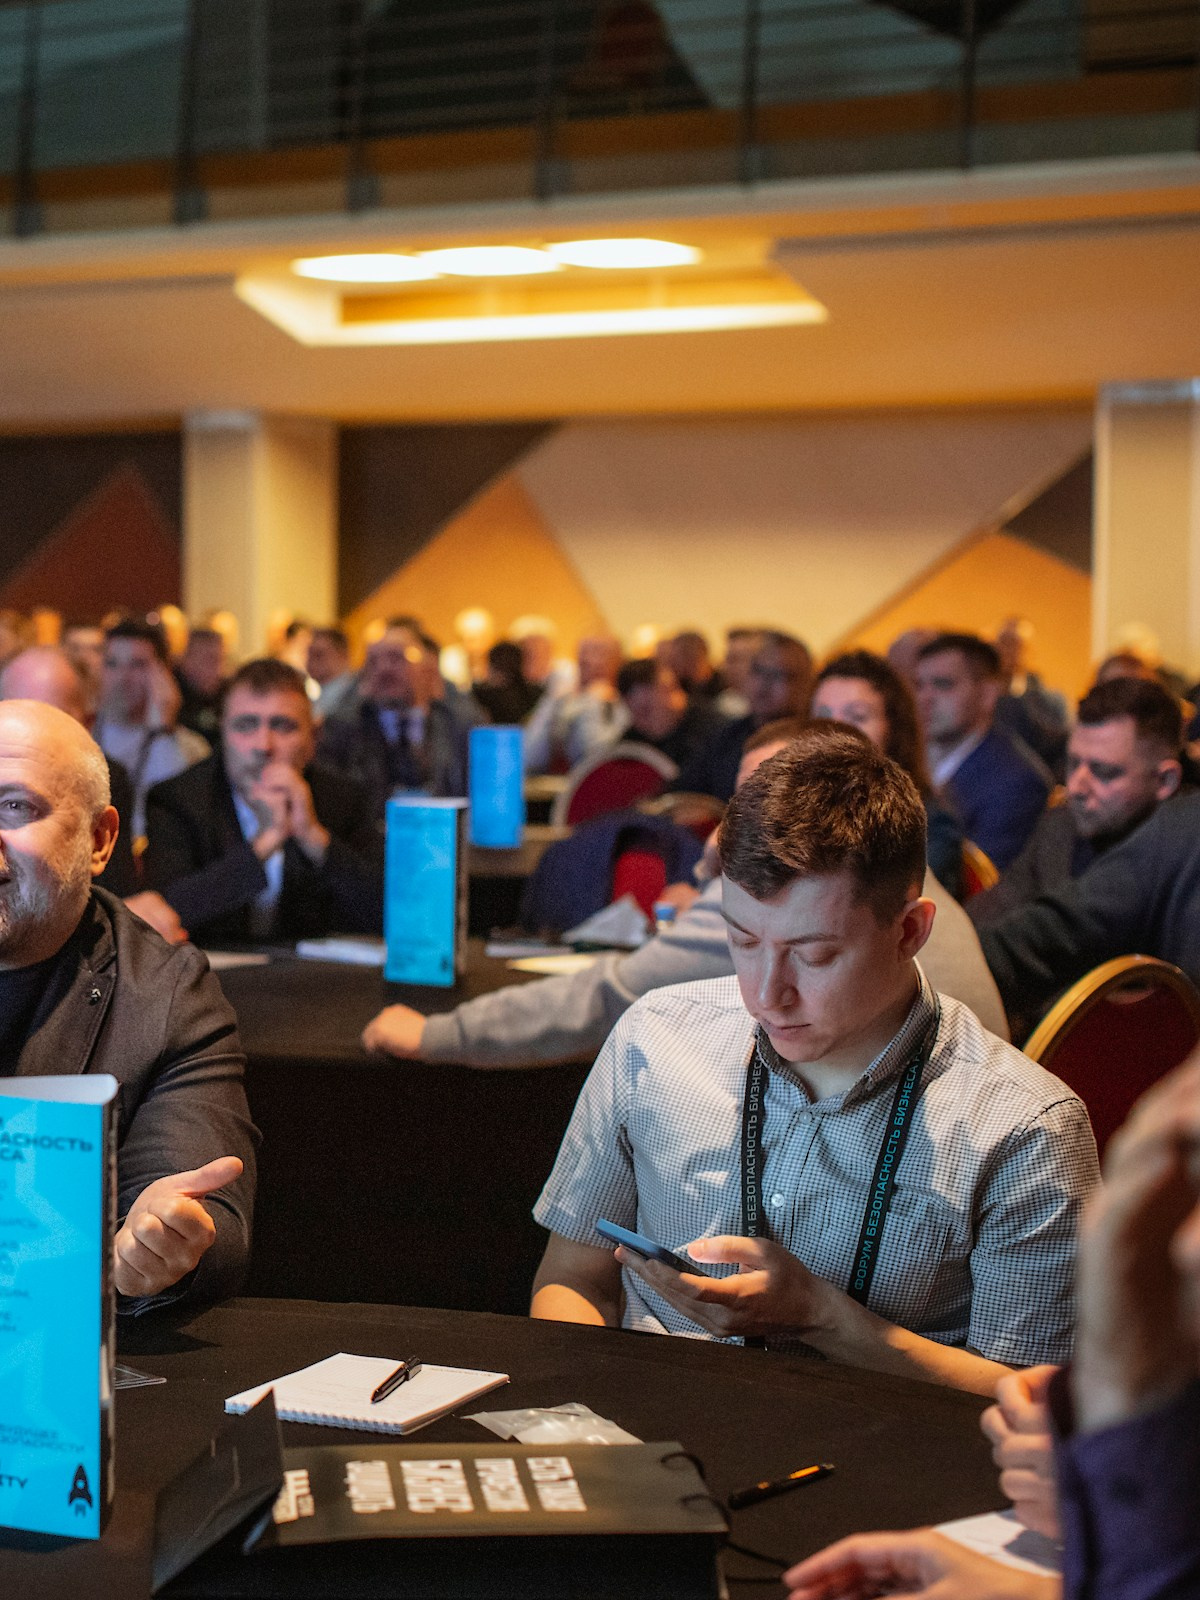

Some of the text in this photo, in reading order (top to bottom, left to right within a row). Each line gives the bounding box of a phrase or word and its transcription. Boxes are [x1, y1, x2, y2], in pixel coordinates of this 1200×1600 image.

[746, 1114, 758, 1221] БЕЗОПАСНОСТЬ
[854, 1239, 874, 1291] ФОРУМ
[866, 1126, 902, 1236] БЕЗОПАСНОСТЬ
[893, 1064, 919, 1127] БИЗНЕСА
